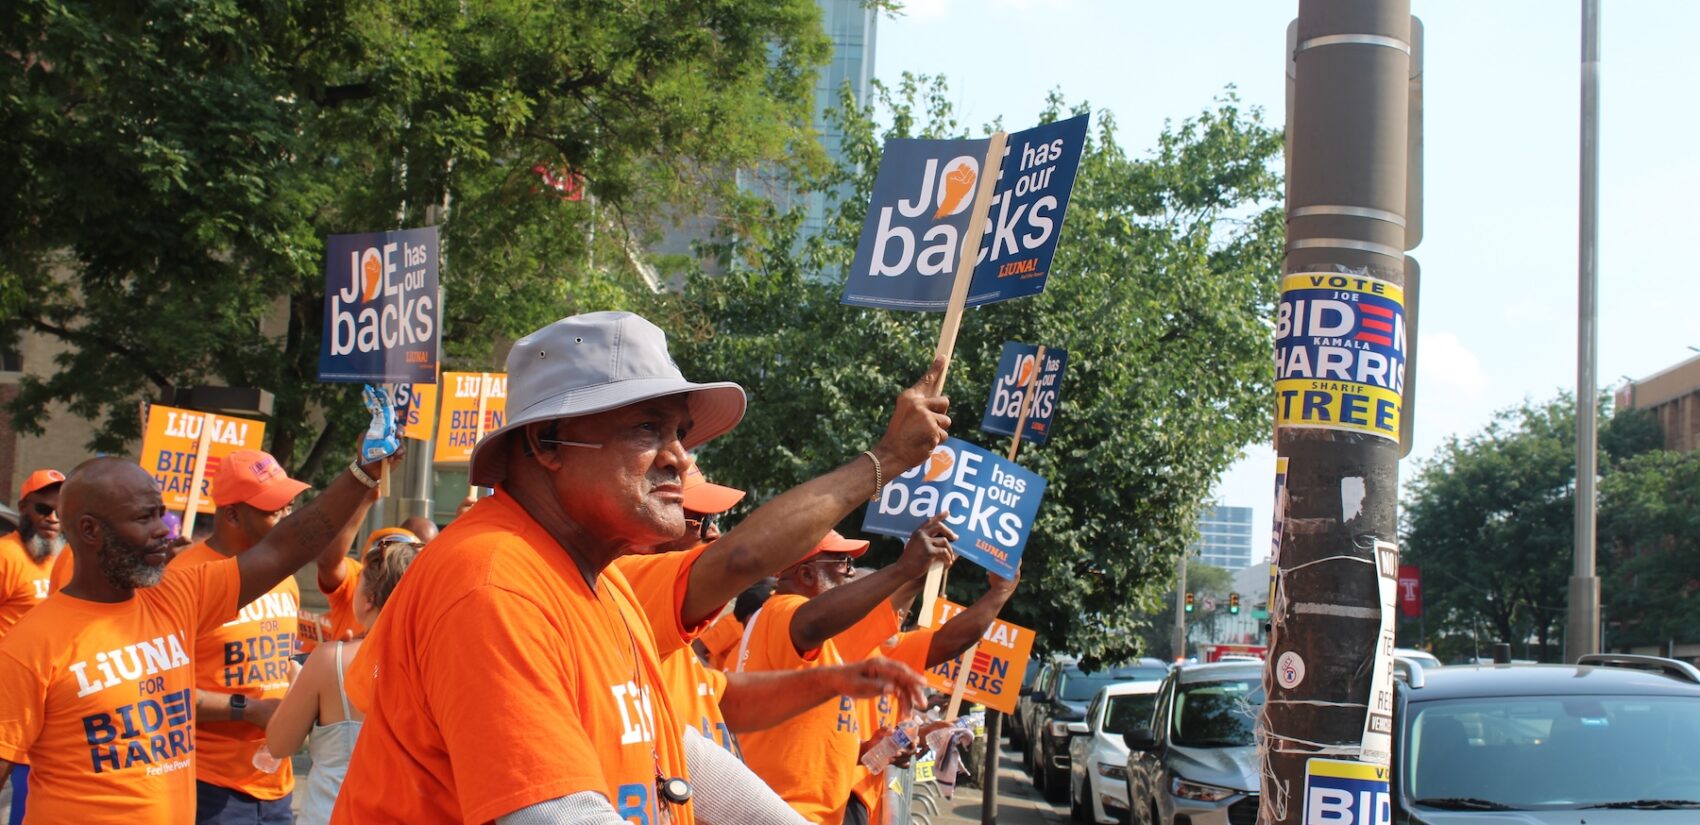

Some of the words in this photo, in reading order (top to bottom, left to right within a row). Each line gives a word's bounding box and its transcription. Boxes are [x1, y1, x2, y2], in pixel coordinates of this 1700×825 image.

[1020, 138, 1064, 171] has
[1015, 165, 1057, 197] our
[340, 242, 398, 303] JOE
[404, 242, 427, 268] has
[405, 268, 426, 292] our
[1310, 276, 1385, 295] VOTE
[1333, 291, 1360, 302] JOE
[331, 283, 434, 356] backs
[1313, 337, 1370, 351] KAMALA
[1045, 355, 1060, 372] has
[1041, 373, 1057, 388] our
[1311, 381, 1365, 394] SHARIF
[1276, 390, 1401, 432] TREE
[990, 464, 1027, 494] has
[987, 482, 1020, 508] our
[878, 480, 1024, 548] backs
[1399, 578, 1419, 602] T
[260, 620, 279, 633] FOR
[224, 632, 295, 666] BIDE
[138, 676, 165, 697] FOR
[224, 660, 288, 687] HARR
[91, 725, 194, 774] HARRI
